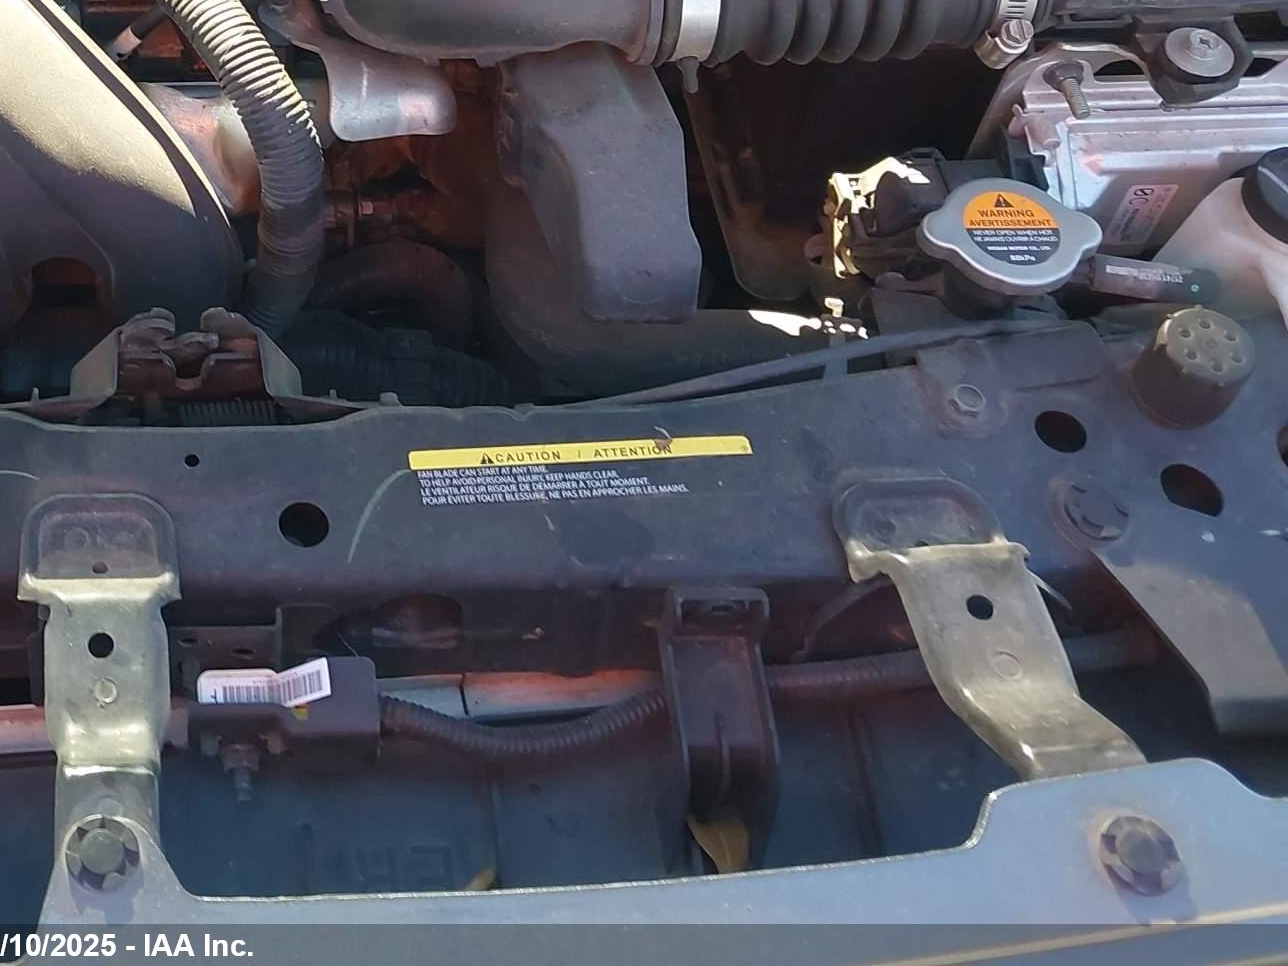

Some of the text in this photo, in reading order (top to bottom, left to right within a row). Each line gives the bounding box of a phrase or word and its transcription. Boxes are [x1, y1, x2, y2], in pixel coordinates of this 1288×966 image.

[969, 218, 1052, 227] AVERTISSEMENT
[977, 209, 1035, 218] WARNING
[495, 450, 561, 463] CAUTION
[593, 445, 673, 458] ATTENTION
[417, 470, 434, 479] FAN
[434, 468, 458, 478] BLADE
[459, 468, 476, 477] CAN
[477, 466, 500, 476] START
[501, 466, 512, 475] AT
[512, 466, 528, 474] ANY
[419, 479, 431, 488] TO
[432, 478, 451, 488] HELP
[452, 476, 476, 486] AVOID
[476, 475, 516, 485] PERSONAL
[546, 472, 564, 482] KEEP
[564, 470, 592, 480] HANDS
[420, 487, 431, 496] LE
[431, 484, 487, 496] VENTILATEUR
[487, 483, 518, 493] RISQUE
[518, 482, 530, 491] DE
[586, 478, 610, 488] TOUT
[422, 496, 448, 506] POUR
[476, 492, 506, 504] TOUTE
[548, 490, 562, 500] NE
[562, 489, 578, 500] PAS
[578, 488, 591, 498] EN
[591, 486, 644, 498] APPROCHER
[643, 484, 658, 494] LES
